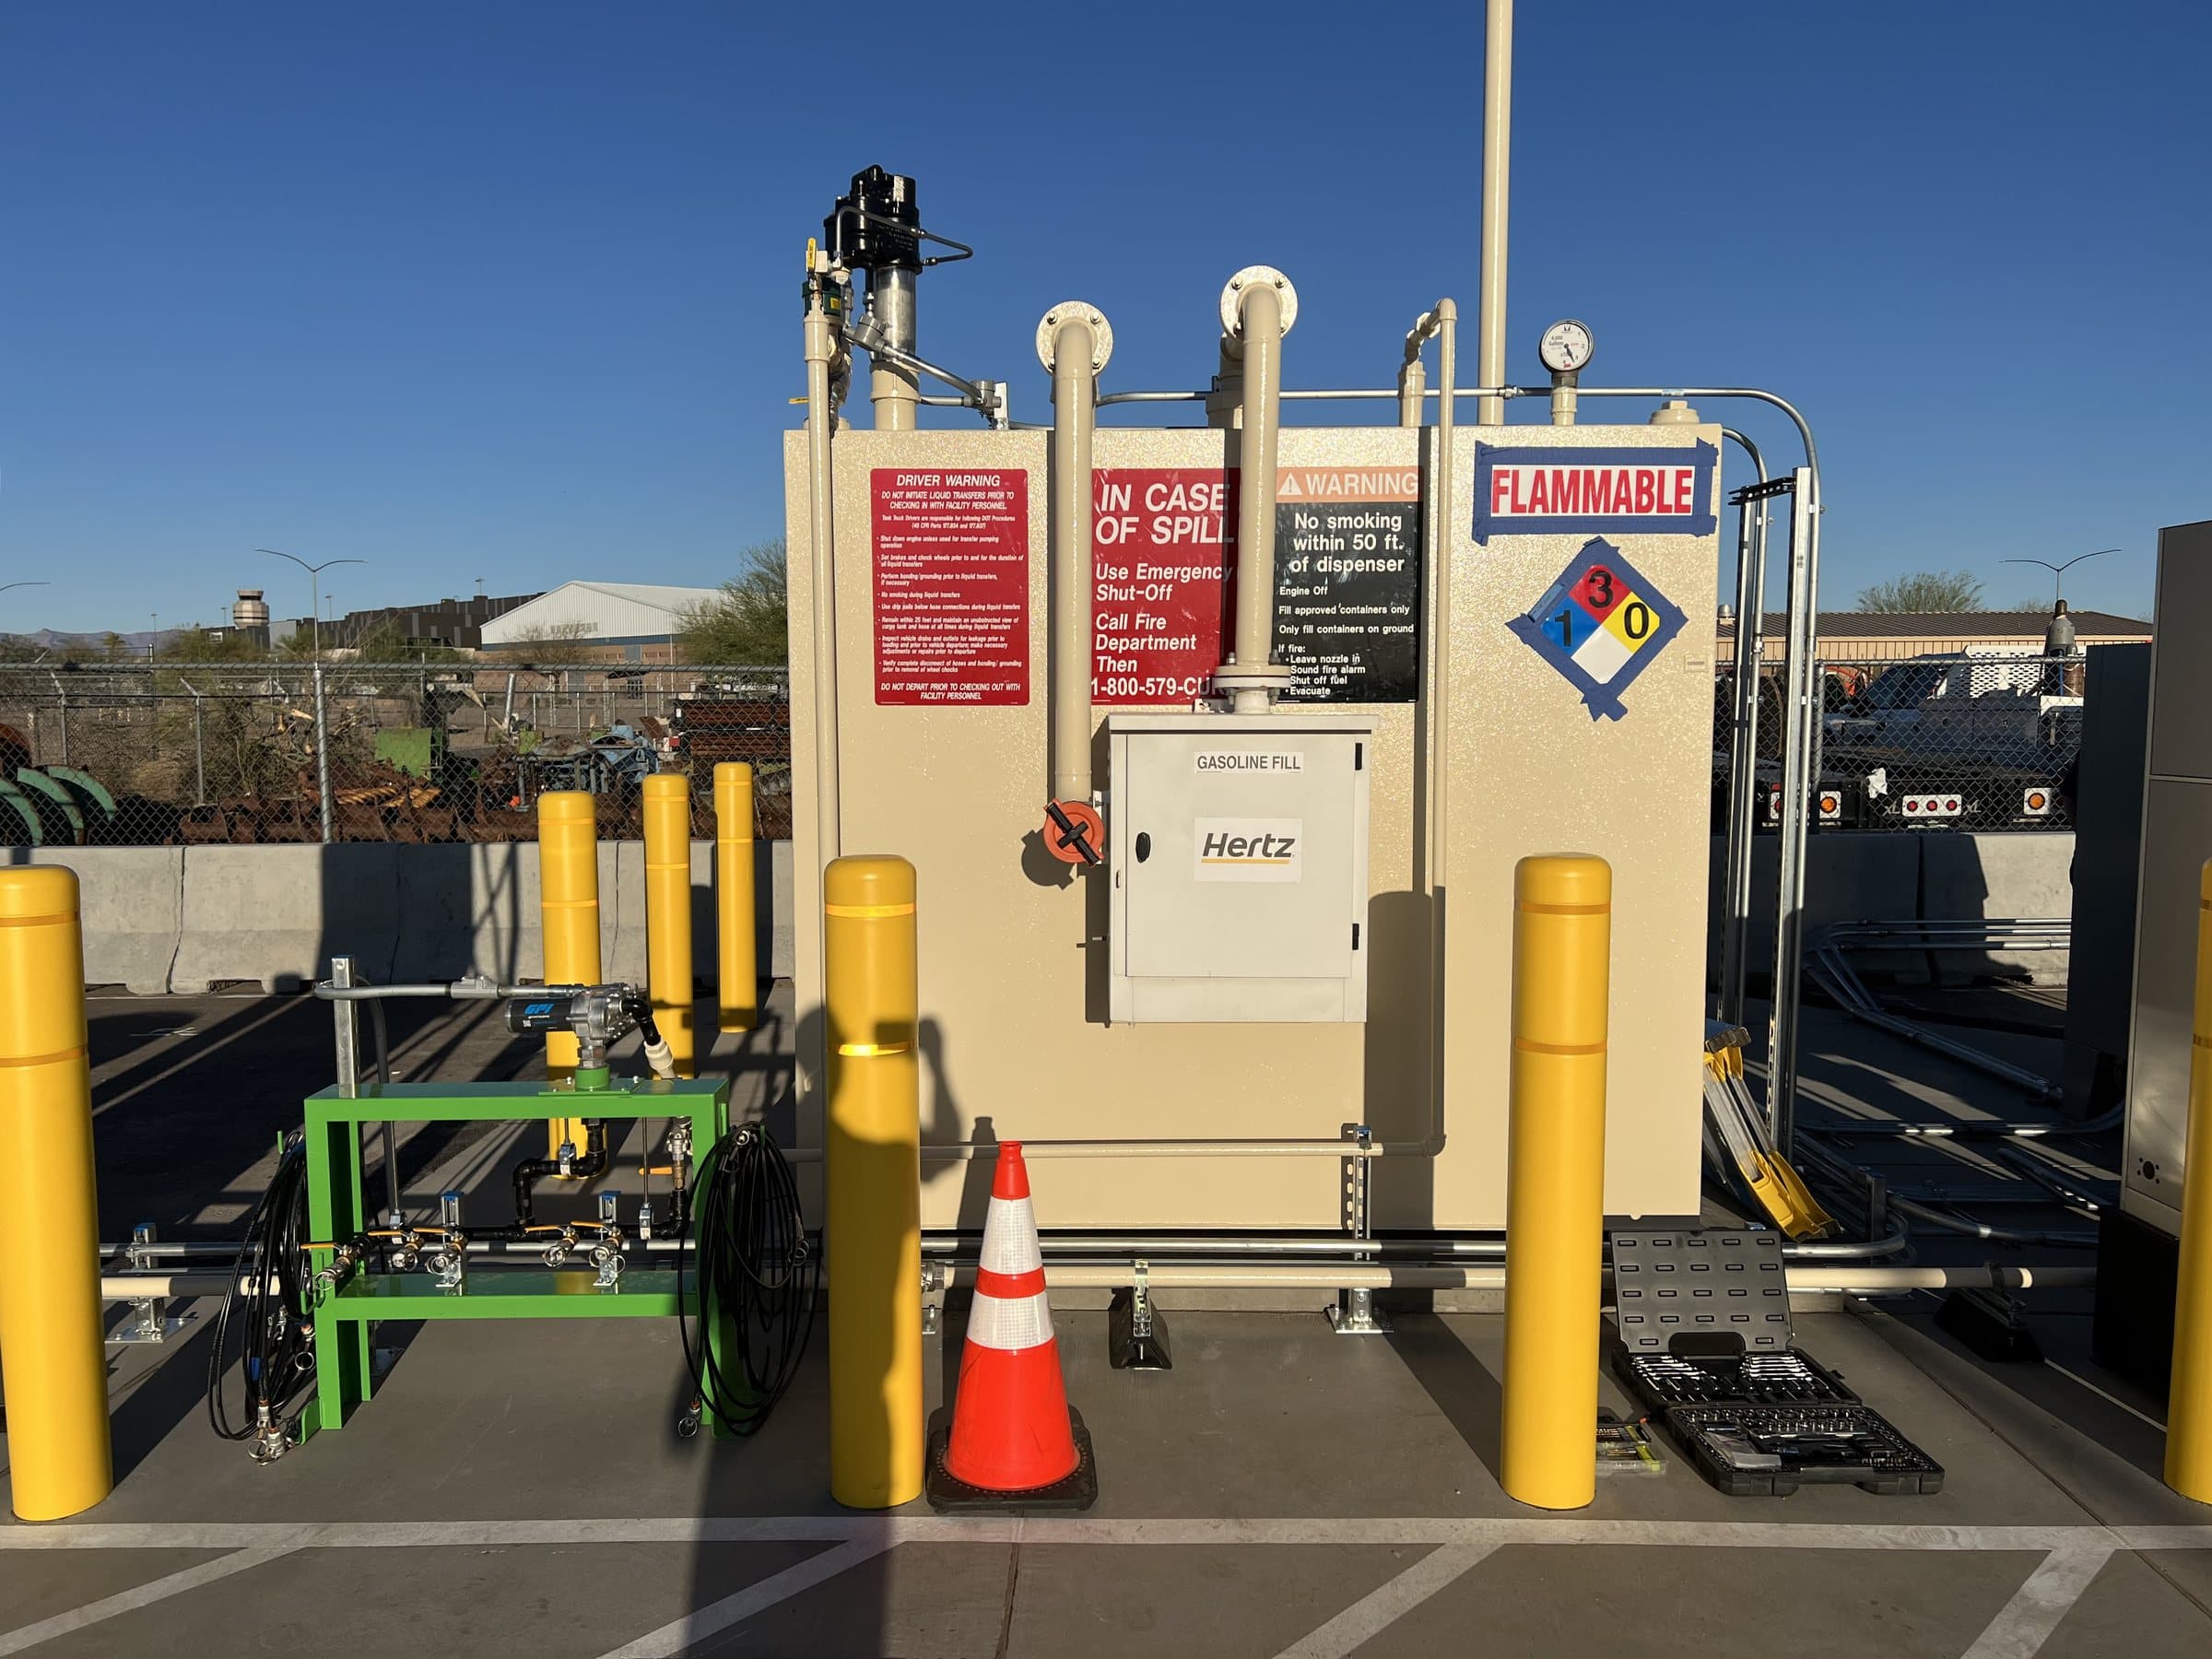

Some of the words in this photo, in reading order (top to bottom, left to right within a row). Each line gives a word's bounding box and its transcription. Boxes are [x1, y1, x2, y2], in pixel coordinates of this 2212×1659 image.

[896, 474, 941, 486] DRIVER
[945, 474, 1001, 486] WARNING
[1305, 472, 1418, 495] WARNING
[881, 491, 891, 499] DO
[891, 491, 905, 499] NOT
[905, 491, 928, 499] INITIATE
[928, 491, 952, 499] LIQUID
[952, 491, 987, 499] TRANSFERS
[987, 491, 1005, 499] PRIOR
[1005, 491, 1015, 499] TO
[1101, 484, 1131, 512] IN
[1145, 484, 1230, 512] CASE
[1491, 469, 1692, 514] FLAMMABLE
[889, 501, 921, 509] CHECKING
[921, 501, 928, 509] IN
[929, 501, 945, 509] WITH
[945, 501, 970, 509] FACILITY
[1295, 513, 1319, 529] No
[1327, 512, 1402, 532] smoking
[1095, 517, 1139, 544] OF
[1151, 517, 1235, 544] SPILL
[1294, 534, 1344, 550] within
[1353, 534, 1376, 550] 50
[1384, 534, 1404, 550] ft.
[1292, 556, 1309, 572] of
[1317, 556, 1405, 575] dispenser
[1096, 564, 1128, 580] Use
[1137, 564, 1232, 583] Emergency
[1096, 584, 1173, 601] Shut-Off
[1280, 587, 1310, 597] Engine
[1313, 586, 1328, 595] Off
[1588, 571, 1614, 608] 3
[1279, 606, 1291, 614] Fill
[1295, 606, 1336, 616] approved
[1340, 605, 1387, 614] containers
[1391, 605, 1410, 615] only
[1096, 613, 1127, 630] Call
[1135, 613, 1166, 630] Fire
[1555, 610, 1571, 647] 1
[1624, 602, 1650, 639] 0
[1279, 625, 1299, 635] Only
[1303, 625, 1313, 633] fill
[1317, 624, 1364, 633] containers
[1382, 624, 1414, 635] ground
[1096, 634, 1197, 654] Department
[1278, 644, 1285, 653] If
[1288, 644, 1306, 653] fire:
[1097, 656, 1137, 672] Then
[1290, 655, 1317, 663] Leave
[1320, 654, 1349, 663] nozzle
[1352, 654, 1360, 663] in
[1291, 665, 1319, 674] Sound
[1322, 665, 1337, 674] fire
[1341, 665, 1366, 673] alarm
[880, 682, 891, 691] DO
[891, 682, 904, 691] NOT
[905, 682, 928, 691] DEPART
[929, 682, 948, 691] PRIOR
[950, 682, 958, 691] TO
[959, 682, 990, 691] CHECKING
[991, 682, 1004, 691] OUT
[1005, 682, 1021, 691] WITH
[1290, 676, 1310, 684] Shut
[1314, 676, 1327, 684] off
[1330, 675, 1347, 684] fuel
[920, 692, 946, 700] FACILITY
[946, 692, 983, 700] PERSONNEL
[1290, 686, 1331, 695] Evacuate
[1197, 755, 1268, 769] GASOLINE
[1272, 756, 1301, 769] FILL
[1202, 833, 1296, 858] Hertz
[524, 1003, 554, 1015] GPI
